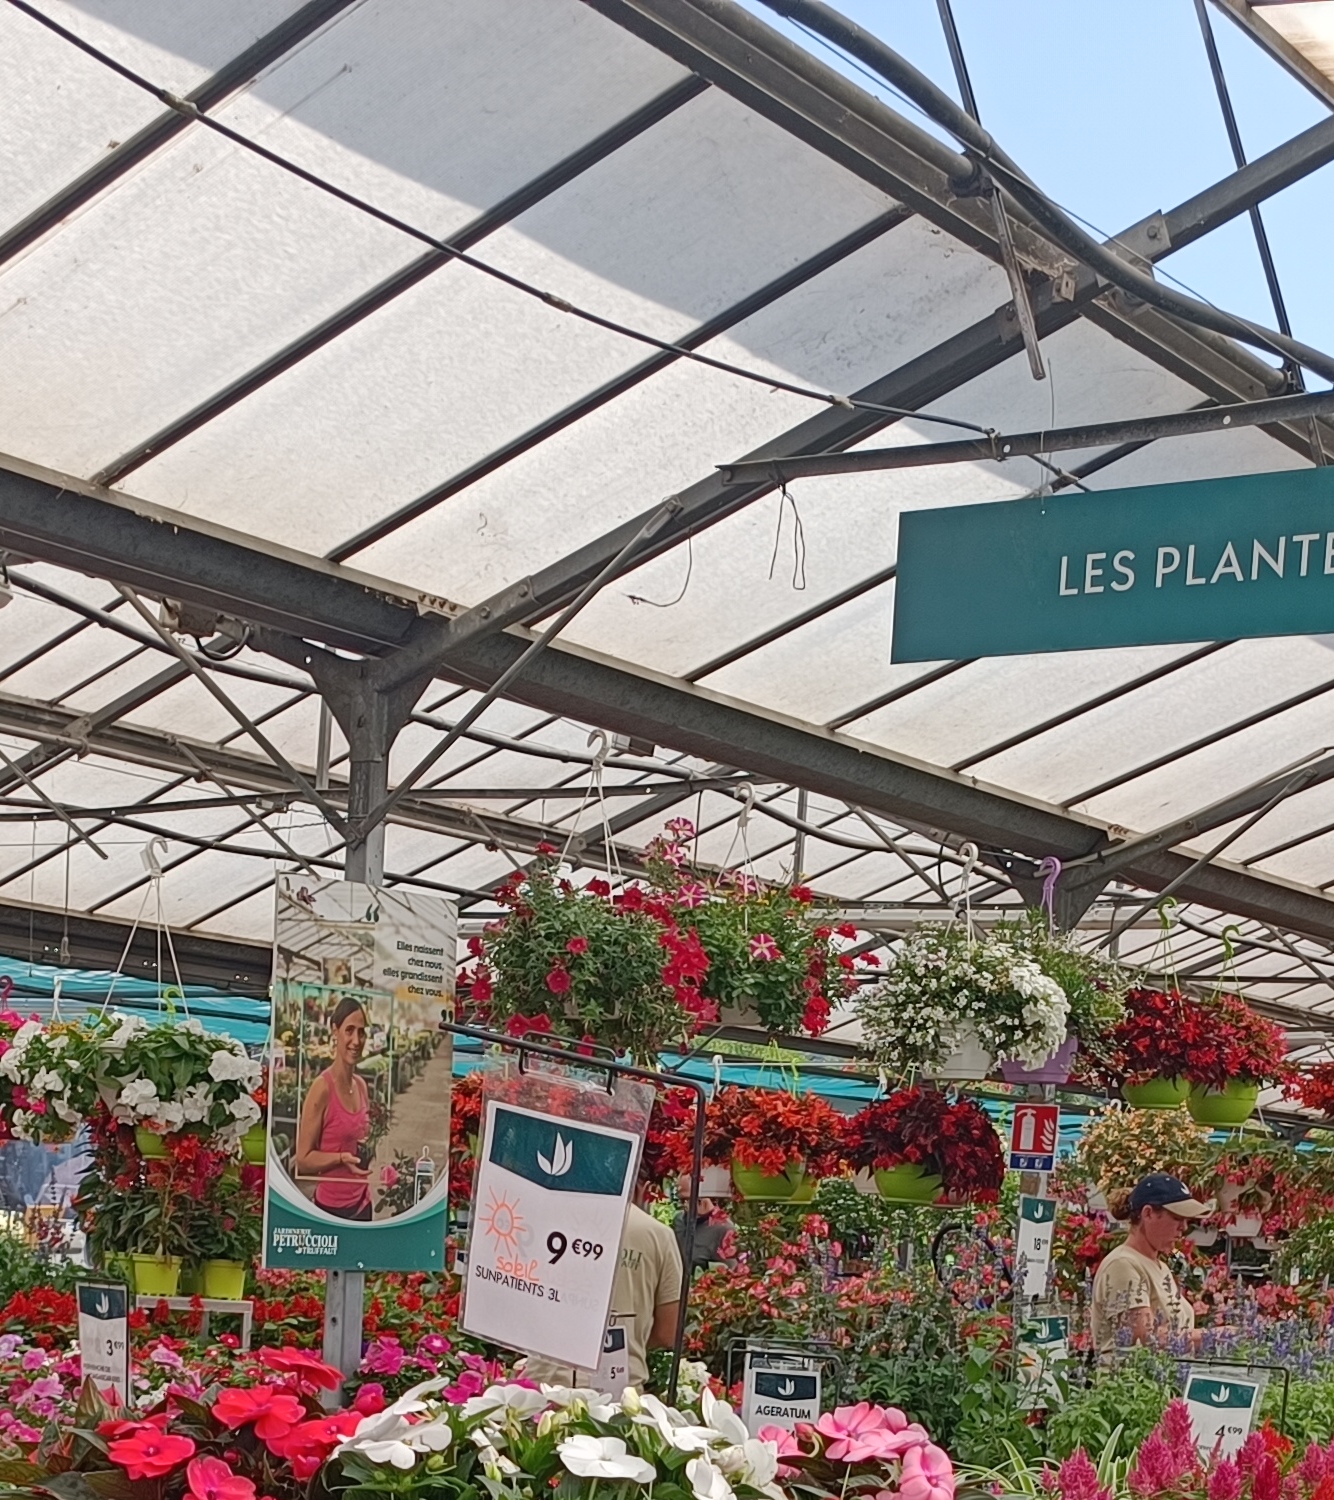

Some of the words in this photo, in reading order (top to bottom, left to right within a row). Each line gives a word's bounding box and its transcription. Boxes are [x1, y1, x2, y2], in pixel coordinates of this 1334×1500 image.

[1059, 551, 1135, 596] LES
[396, 940, 413, 952] Elles
[413, 945, 444, 956] naissent
[407, 957, 424, 968] chez
[382, 967, 400, 978] elles
[400, 970, 443, 984] grandissent
[407, 984, 424, 995] chez
[272, 1233, 339, 1248] PETRUCCIOLI
[474, 1264, 545, 1298] SUNPATIENTS
[547, 1287, 561, 1303] 3L
[754, 1404, 812, 1420] AGERATUM
